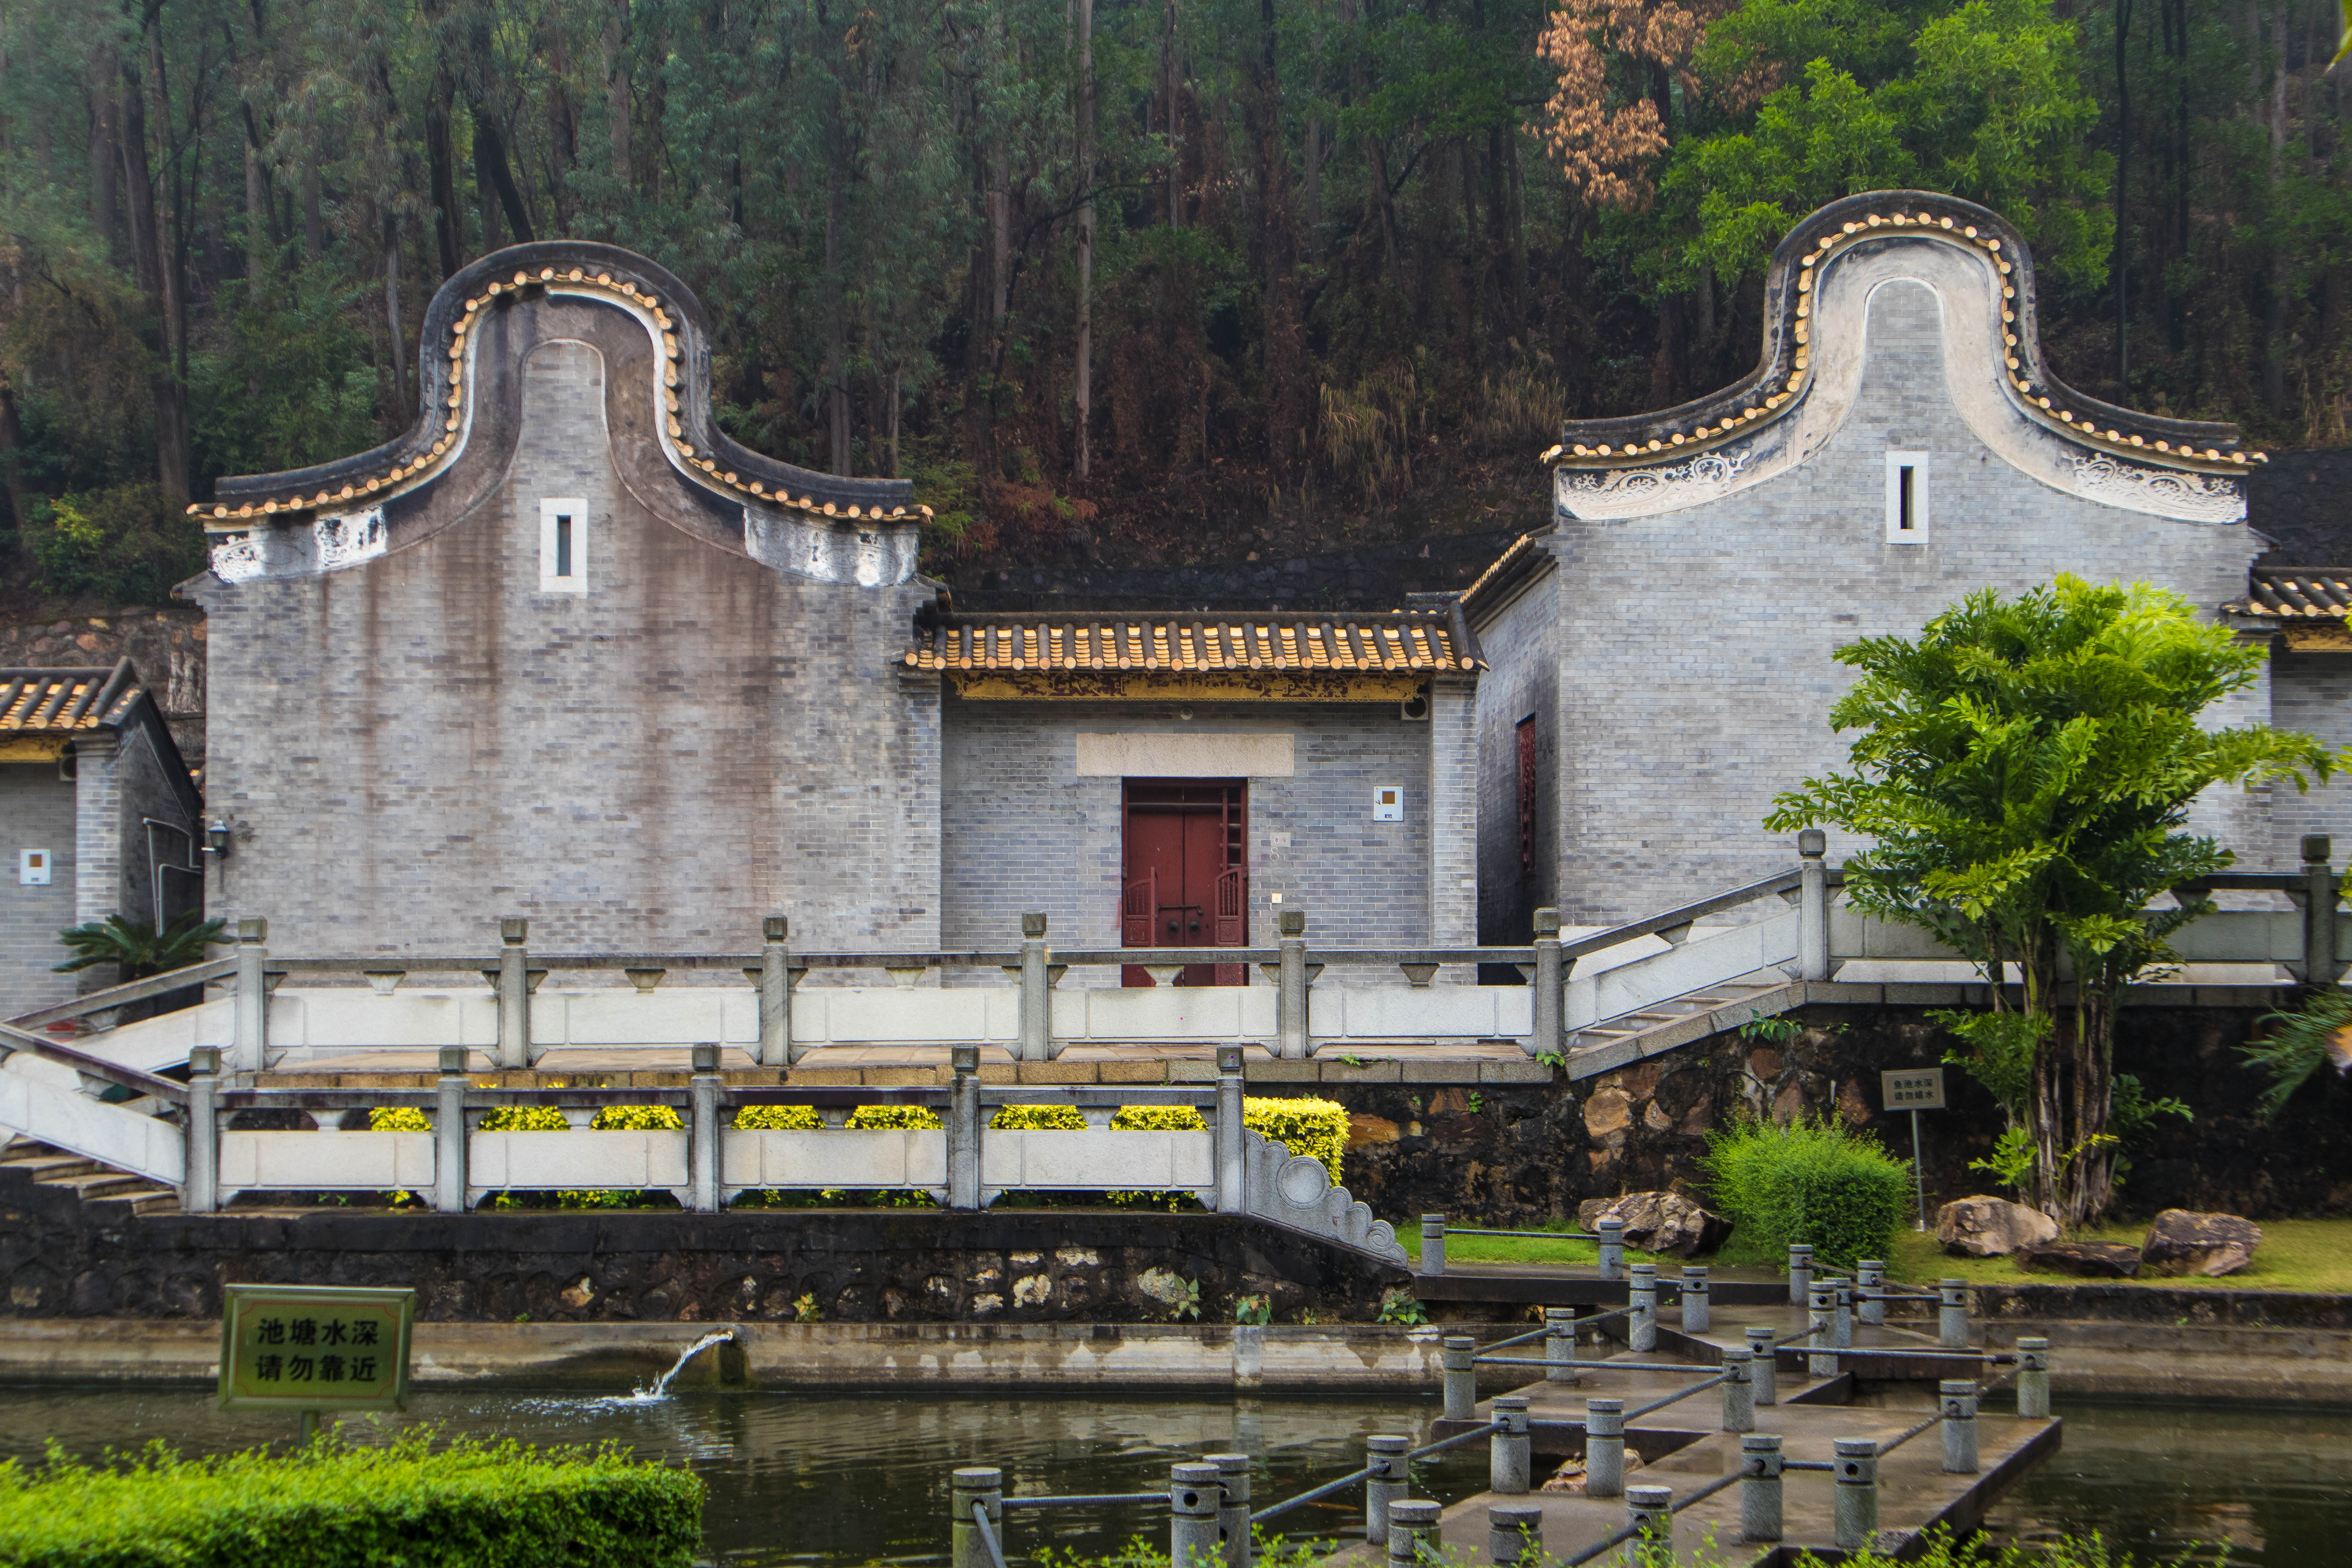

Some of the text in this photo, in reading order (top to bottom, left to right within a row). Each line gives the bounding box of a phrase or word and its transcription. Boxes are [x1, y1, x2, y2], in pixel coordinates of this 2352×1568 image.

[258, 1317, 378, 1346] 池塘水深
[256, 1354, 376, 1382] 请勿靠近
